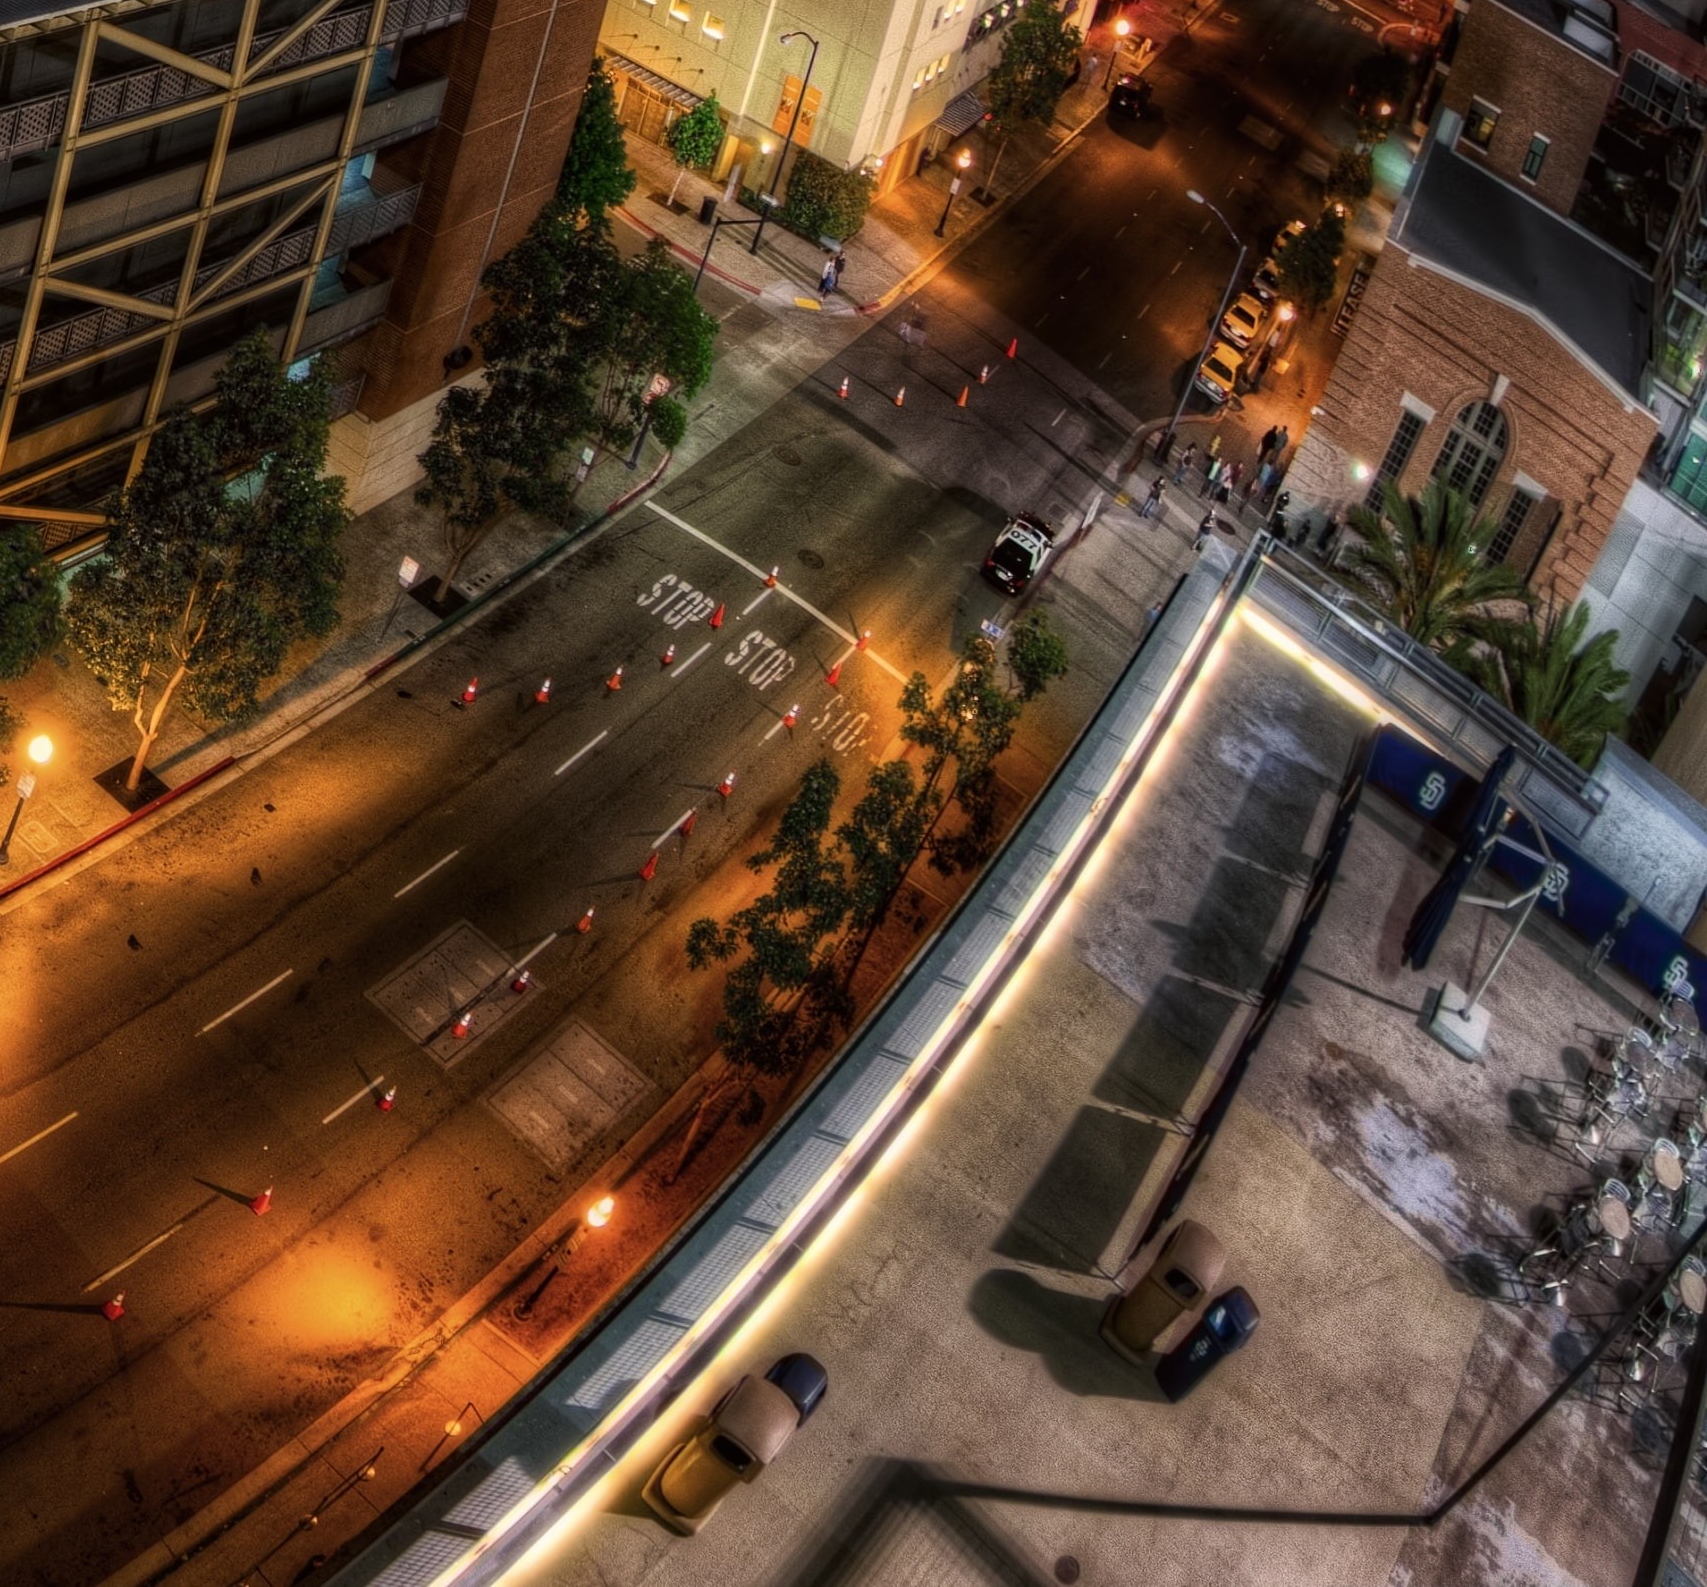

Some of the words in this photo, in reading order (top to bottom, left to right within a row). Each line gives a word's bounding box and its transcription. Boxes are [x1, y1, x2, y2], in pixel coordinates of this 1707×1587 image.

[1011, 530, 1037, 550] 077
[636, 573, 715, 630] STOP
[724, 630, 795, 691] STOP
